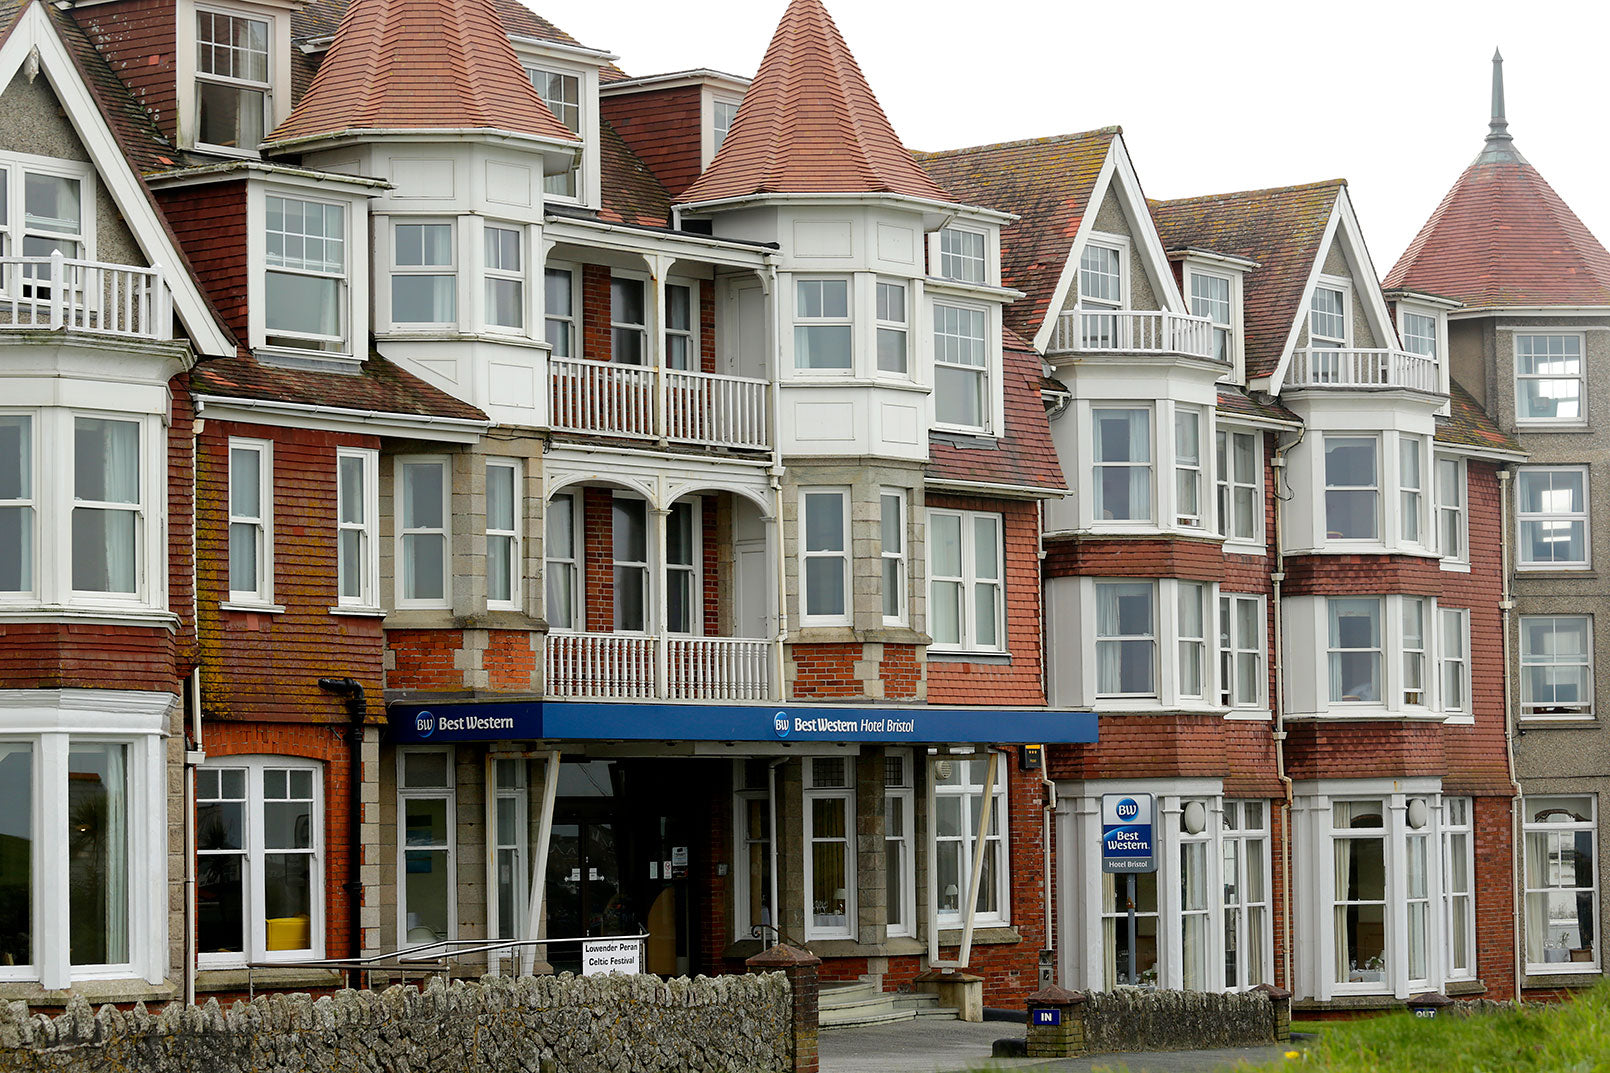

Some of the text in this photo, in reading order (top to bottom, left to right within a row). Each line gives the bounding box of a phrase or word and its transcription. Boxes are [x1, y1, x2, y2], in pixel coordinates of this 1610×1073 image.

[417, 716, 514, 731] BW Best Western
[775, 717, 914, 733] BW Best Western Hotel Bristol
[1118, 804, 1137, 816] BW
[1117, 831, 1139, 841] Best
[1107, 840, 1148, 850] Western
[585, 943, 638, 953] Lowender Peran
[588, 956, 635, 966] Celtic Festival
[1040, 1012, 1052, 1022] IN
[1415, 1010, 1435, 1018] OUT
